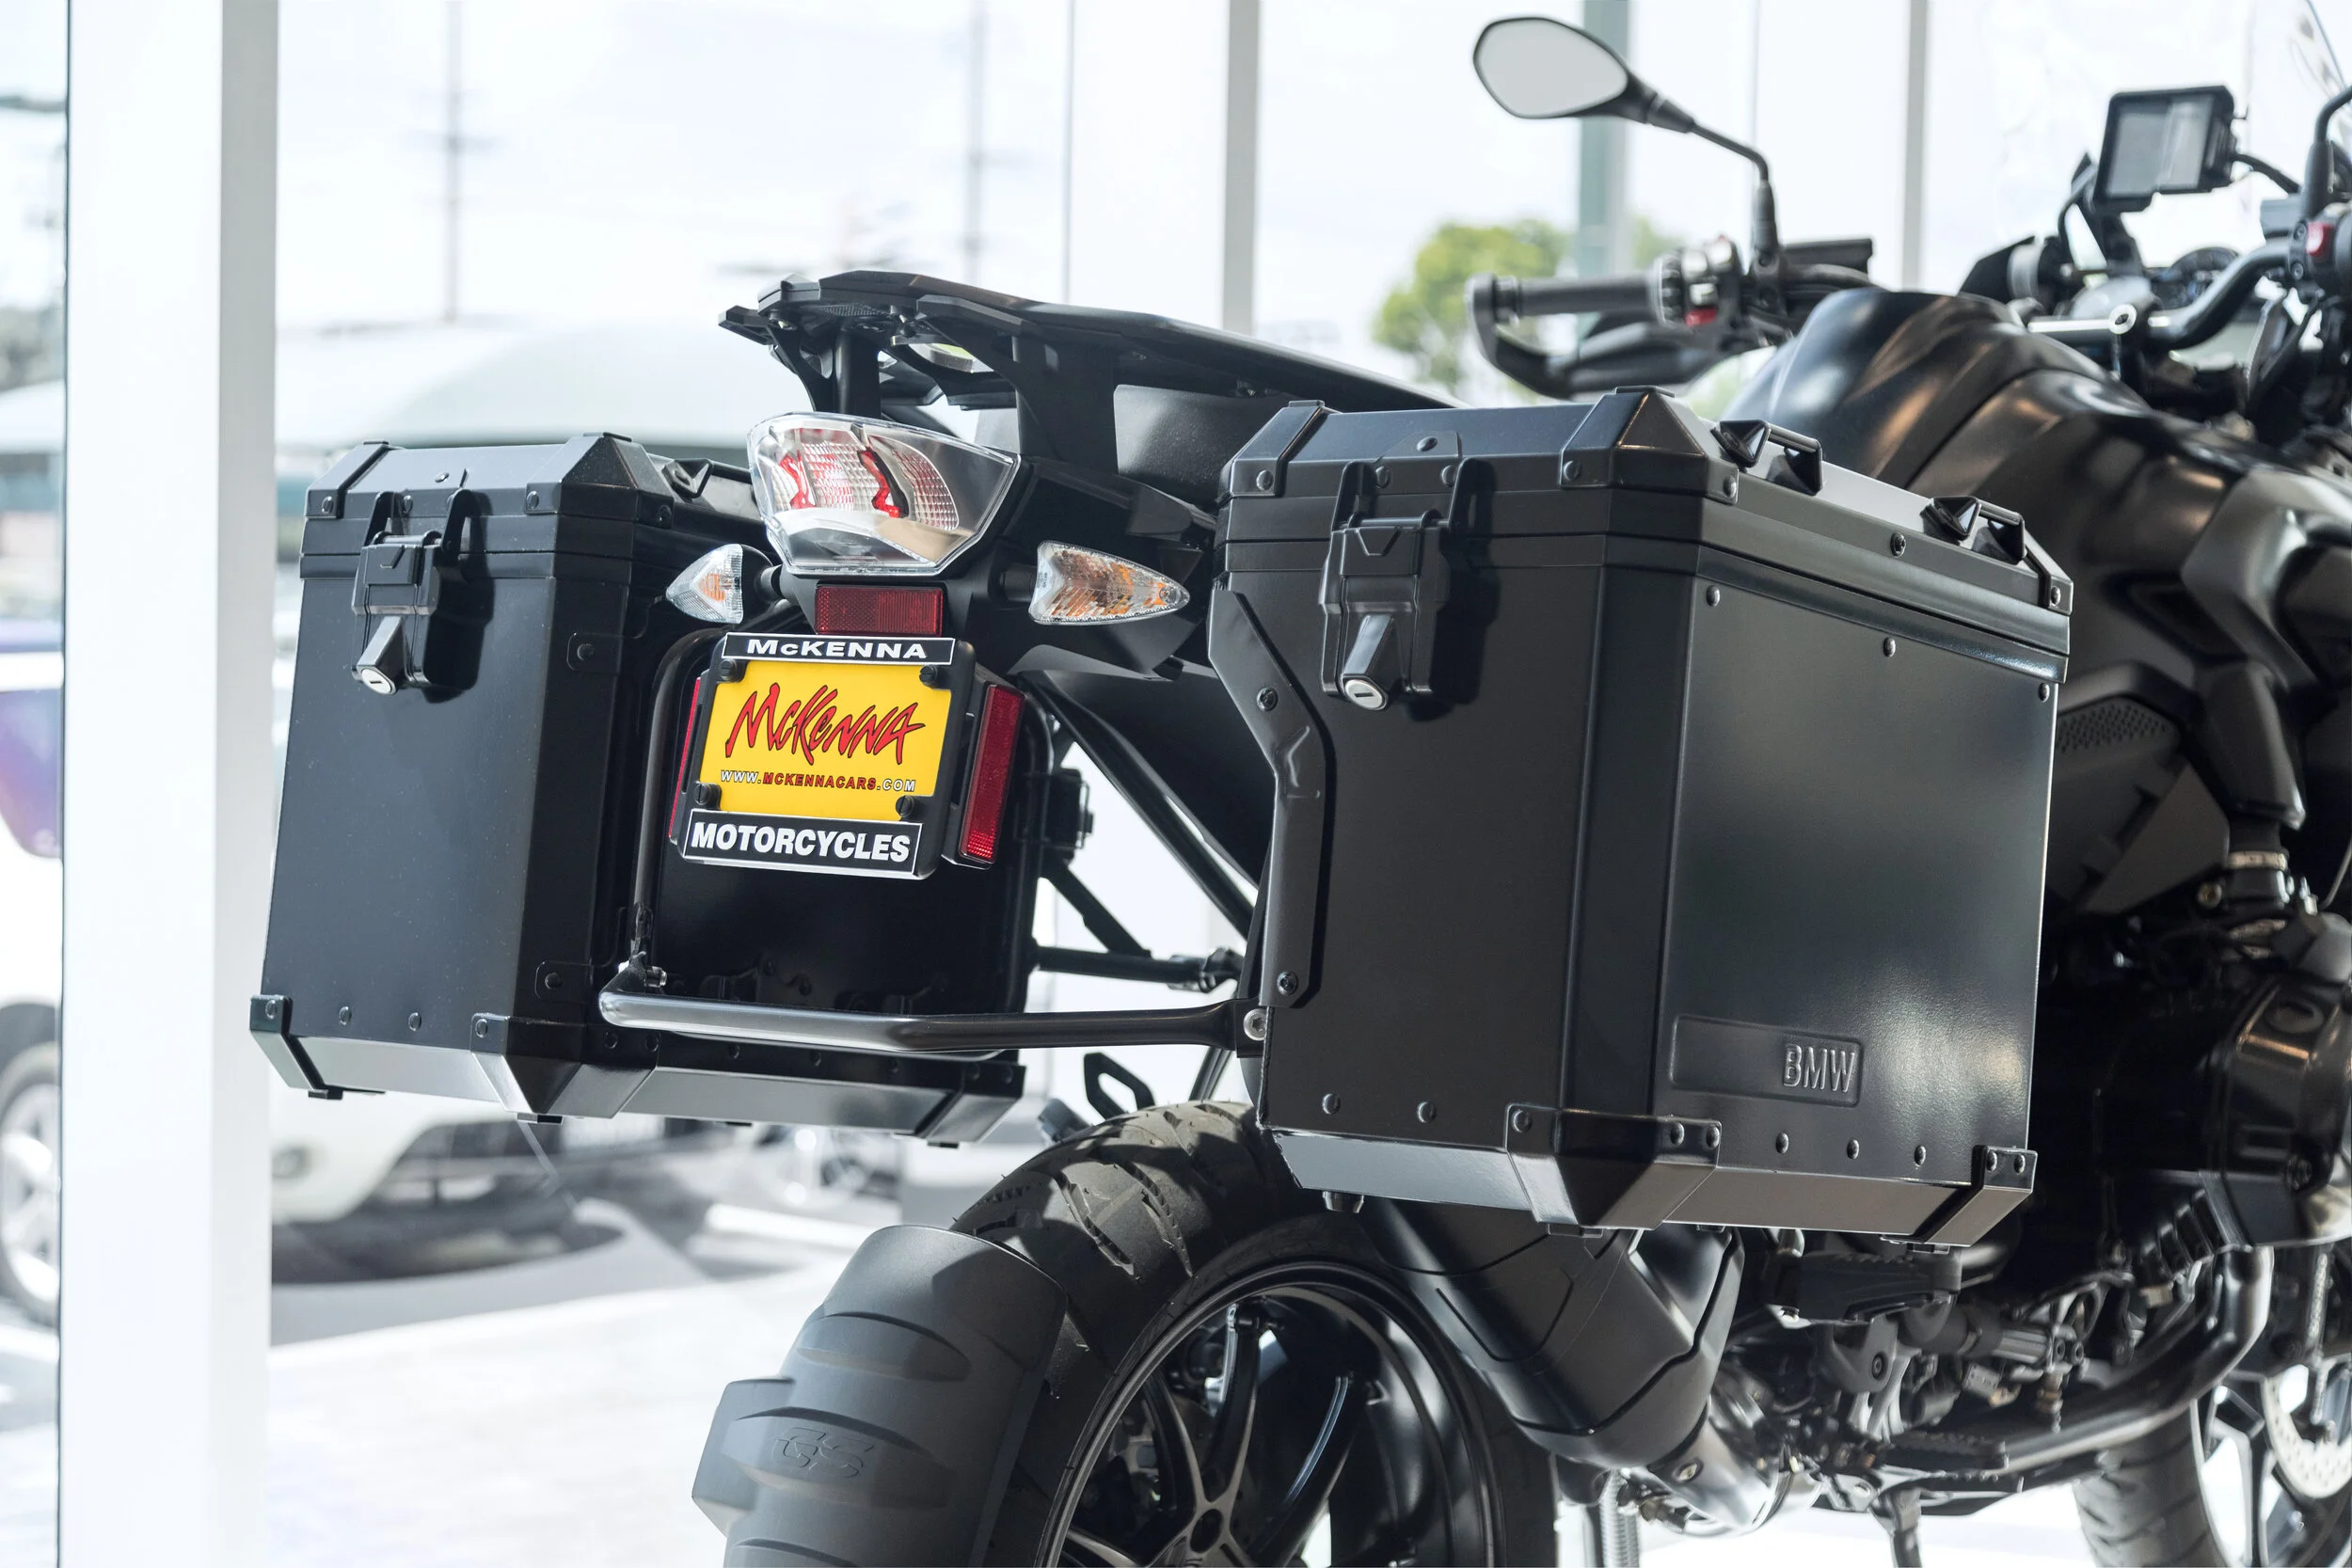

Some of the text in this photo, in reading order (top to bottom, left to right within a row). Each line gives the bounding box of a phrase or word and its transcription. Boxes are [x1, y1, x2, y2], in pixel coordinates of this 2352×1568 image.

[747, 640, 927, 658] McKENNA
[721, 770, 915, 792] WWW.MCKENNACARS.COM
[691, 822, 910, 863] MOTORCYCLES
[1784, 1044, 1855, 1092] BMW
